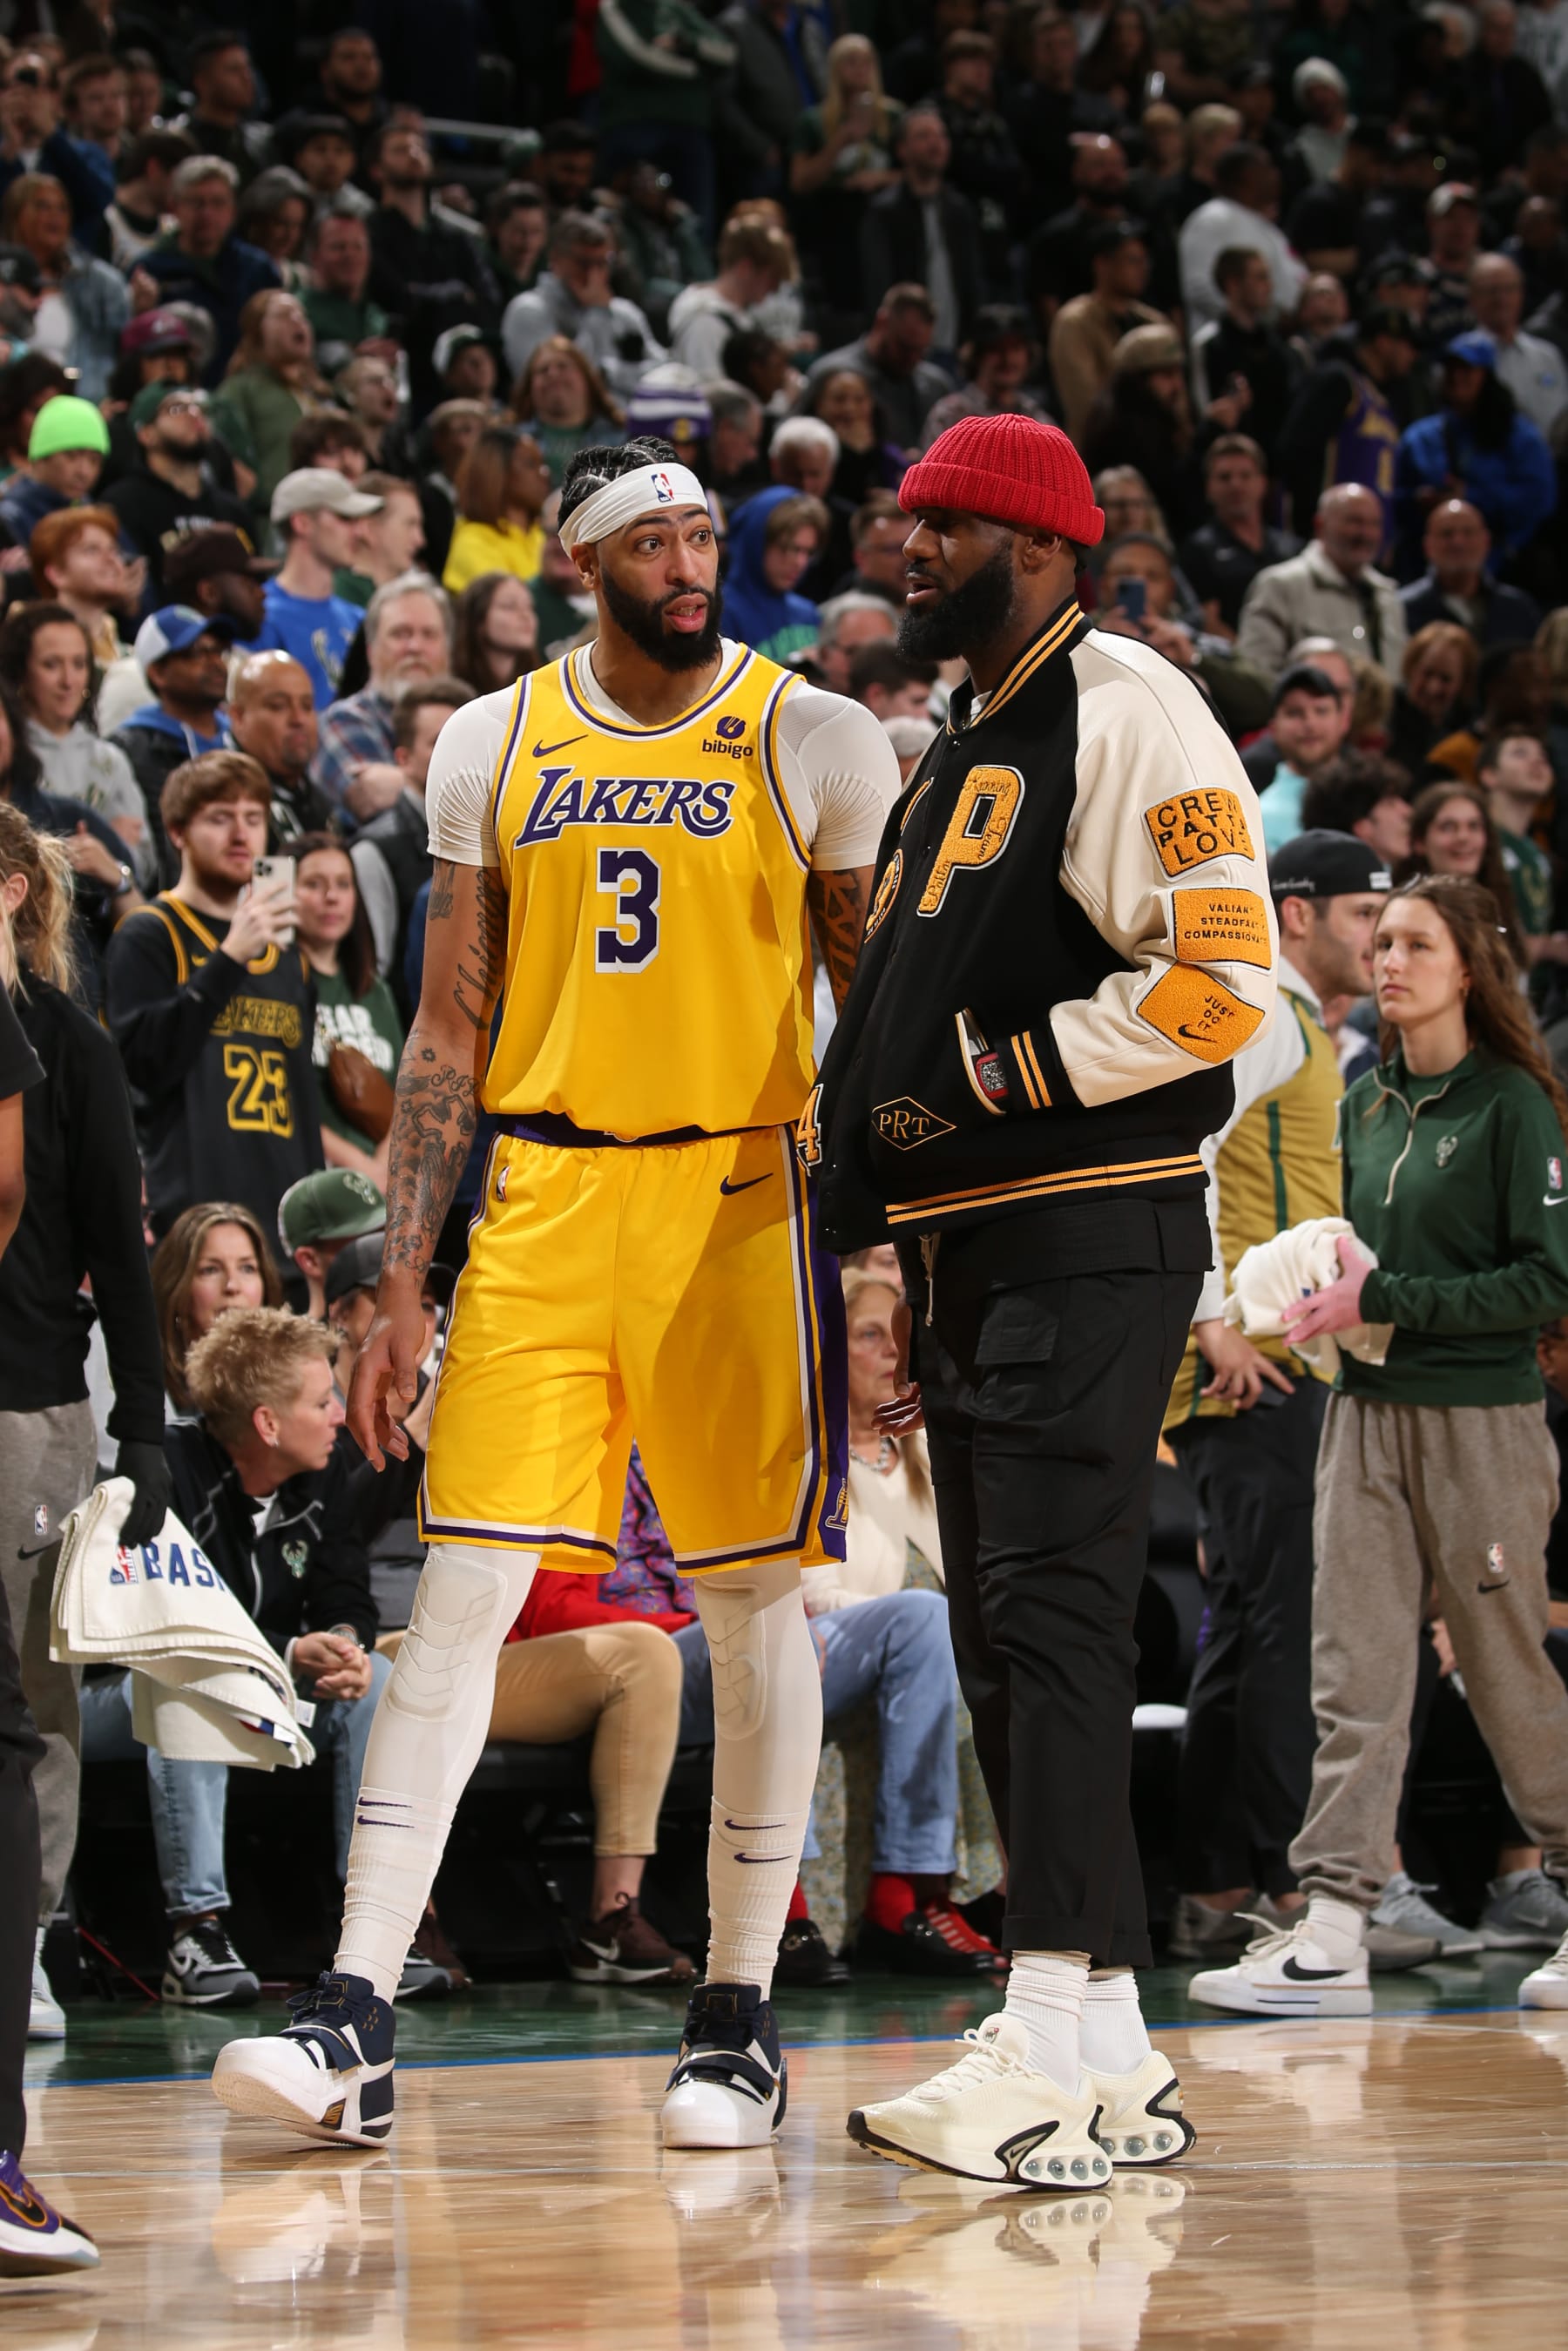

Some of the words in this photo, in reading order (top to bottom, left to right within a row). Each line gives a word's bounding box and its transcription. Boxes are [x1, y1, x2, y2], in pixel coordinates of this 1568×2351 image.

[701, 739, 754, 760] bibigo
[513, 765, 738, 850] LAKERS
[917, 764, 1025, 917] P
[595, 846, 661, 974] 3
[1209, 903, 1254, 914] VALIAN
[879, 1109, 930, 1139] PRT
[140, 1541, 226, 1591] BAS
